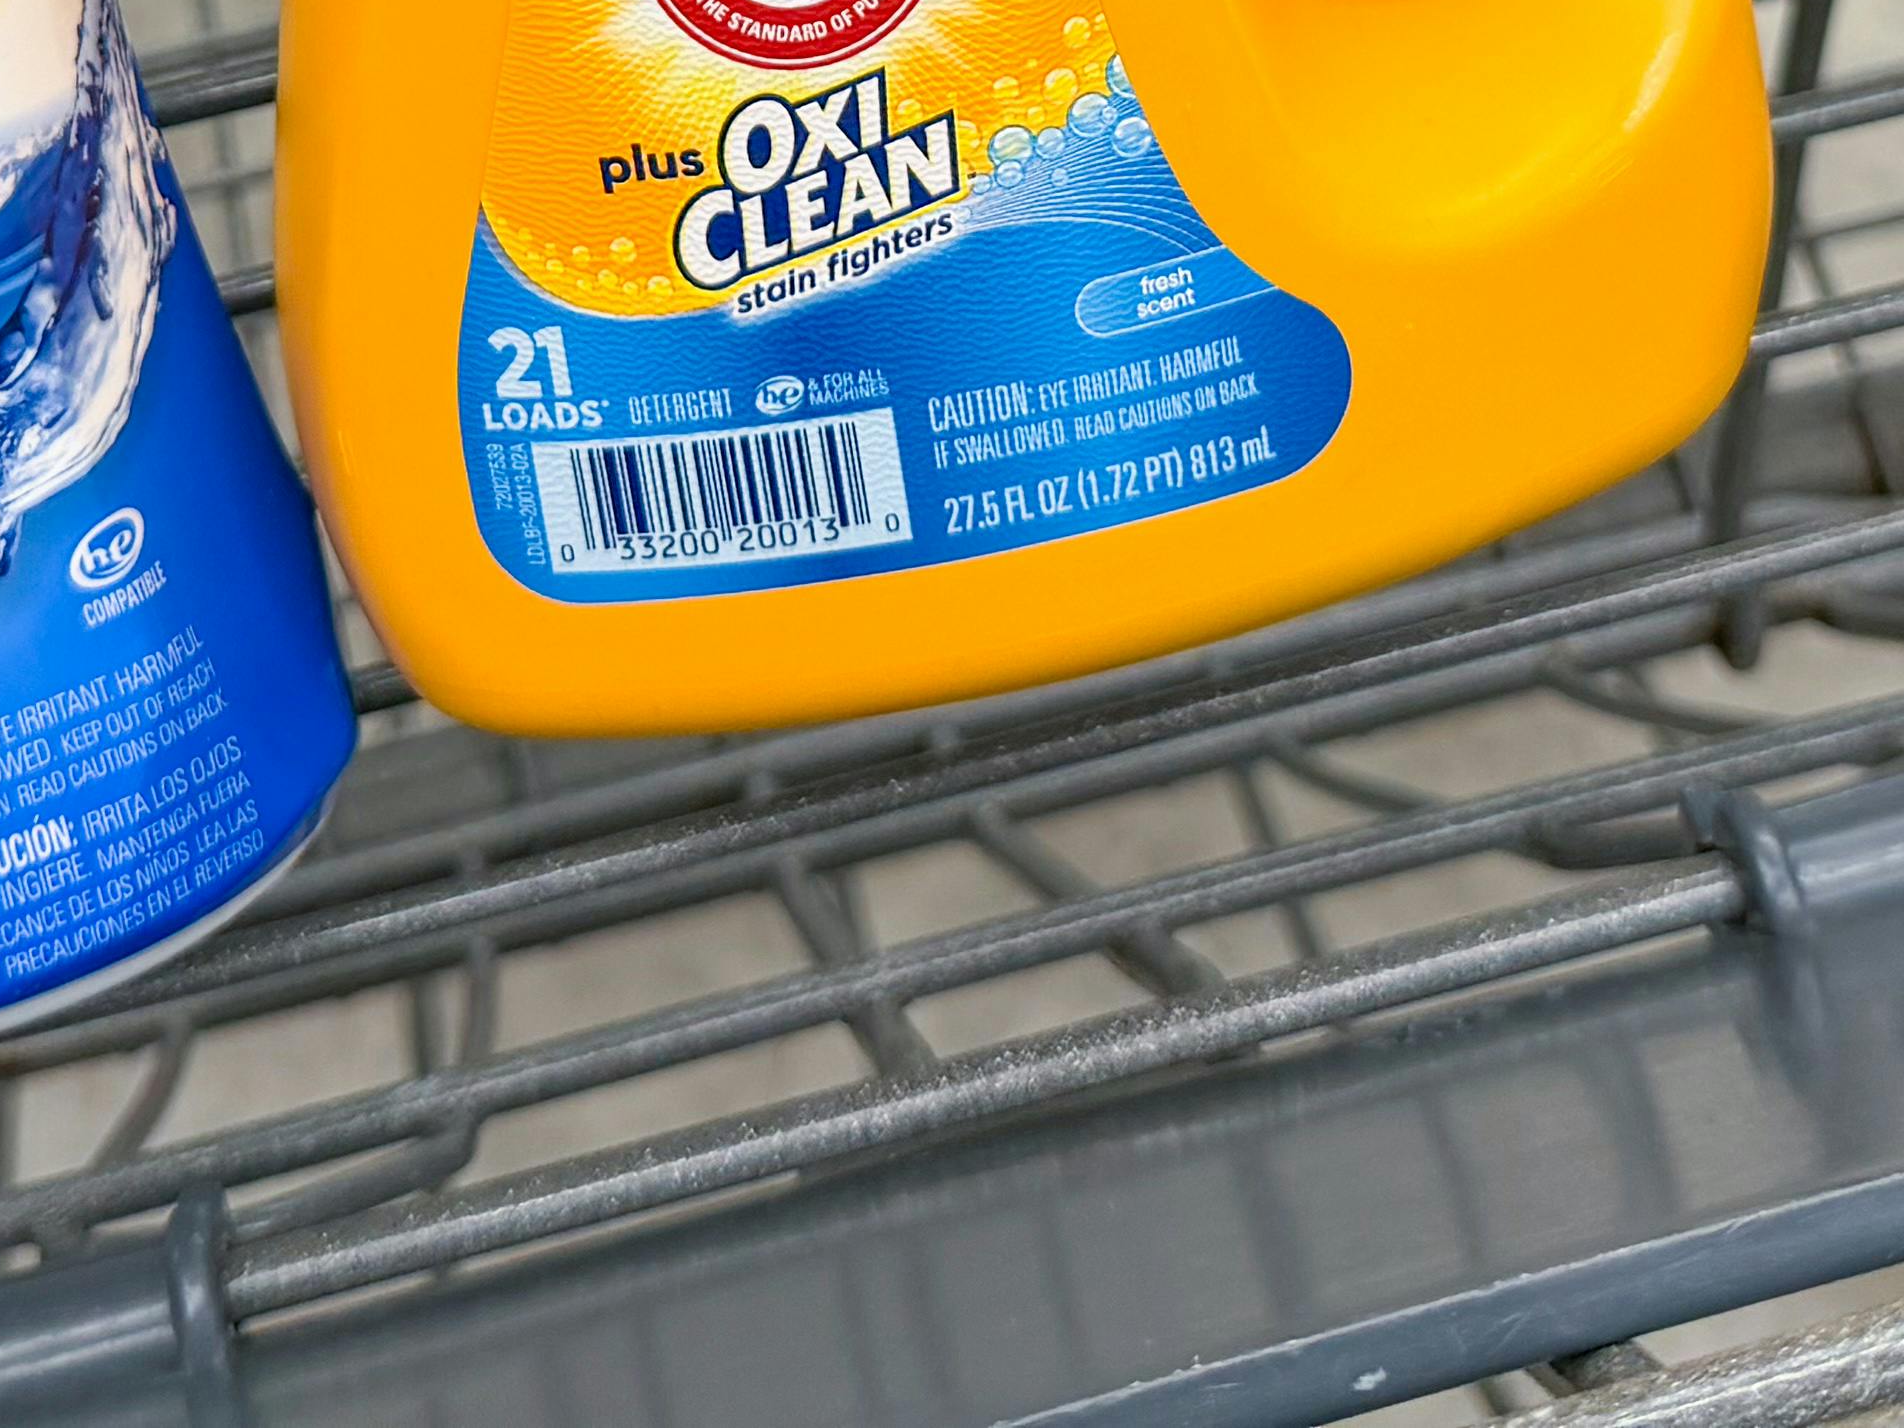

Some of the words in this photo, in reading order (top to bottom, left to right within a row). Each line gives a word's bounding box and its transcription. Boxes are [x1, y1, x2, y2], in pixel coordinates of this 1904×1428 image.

[726, 11, 828, 44] STANDARD
[829, 12, 854, 34] OF
[598, 142, 705, 195] plus
[723, 70, 886, 195] OXI
[679, 114, 959, 288] CLEAN
[735, 266, 818, 315] stain
[825, 212, 955, 289] fighters
[1136, 287, 1196, 319] scent
[1140, 267, 1194, 296] fresh
[487, 325, 574, 400] 21
[627, 386, 733, 426] DETERGENT
[808, 378, 818, 391] &
[823, 372, 853, 388] FOR
[858, 368, 886, 384] ALL
[809, 381, 890, 405] MACHINES
[928, 378, 1036, 433] CAUTION:
[1039, 381, 1069, 412] EYE
[1072, 360, 1157, 405] IRRITANT.
[1159, 335, 1244, 383] HARMFUL
[933, 440, 952, 470] IF
[955, 417, 1070, 466] SWALLOWED.
[1074, 409, 1116, 443] READ
[1118, 391, 1194, 432] CAUTIONS
[1194, 385, 1217, 413] ON
[1219, 371, 1260, 406] BACK
[943, 488, 1001, 536] 27.5
[1005, 483, 1035, 524] FL
[1037, 474, 1075, 518] OZ
[1077, 460, 1141, 512] (1.72
[1143, 445, 1184, 494] PT)
[1190, 434, 1237, 482] 813
[617, 529, 720, 562] 33200
[736, 517, 842, 552] 20013
[82, 560, 168, 628] COMPATIBLE
[16, 674, 114, 733] IRRITANT.
[114, 624, 205, 697] HARMFUL
[60, 721, 103, 754] KEEP
[104, 703, 142, 735] OUT
[144, 692, 166, 720] OF
[166, 656, 217, 710] REACH
[17, 772, 67, 806] READ
[69, 732, 160, 788] CAUTIONS
[158, 716, 185, 746] ON
[187, 686, 230, 728] BACK
[0, 852, 94, 912] INGIERE.
[96, 807, 199, 869] MANTENGA
[198, 771, 252, 820] FUERA
[82, 792, 150, 843] IRRITA
[150, 767, 189, 811] LOS
[5, 905, 146, 979] PRECAUCIONES
[147, 891, 174, 918] EN
[194, 829, 266, 888] REVERSO
[70, 895, 97, 923] DE
[98, 879, 134, 911] LOS
[228, 799, 260, 838] LAS
